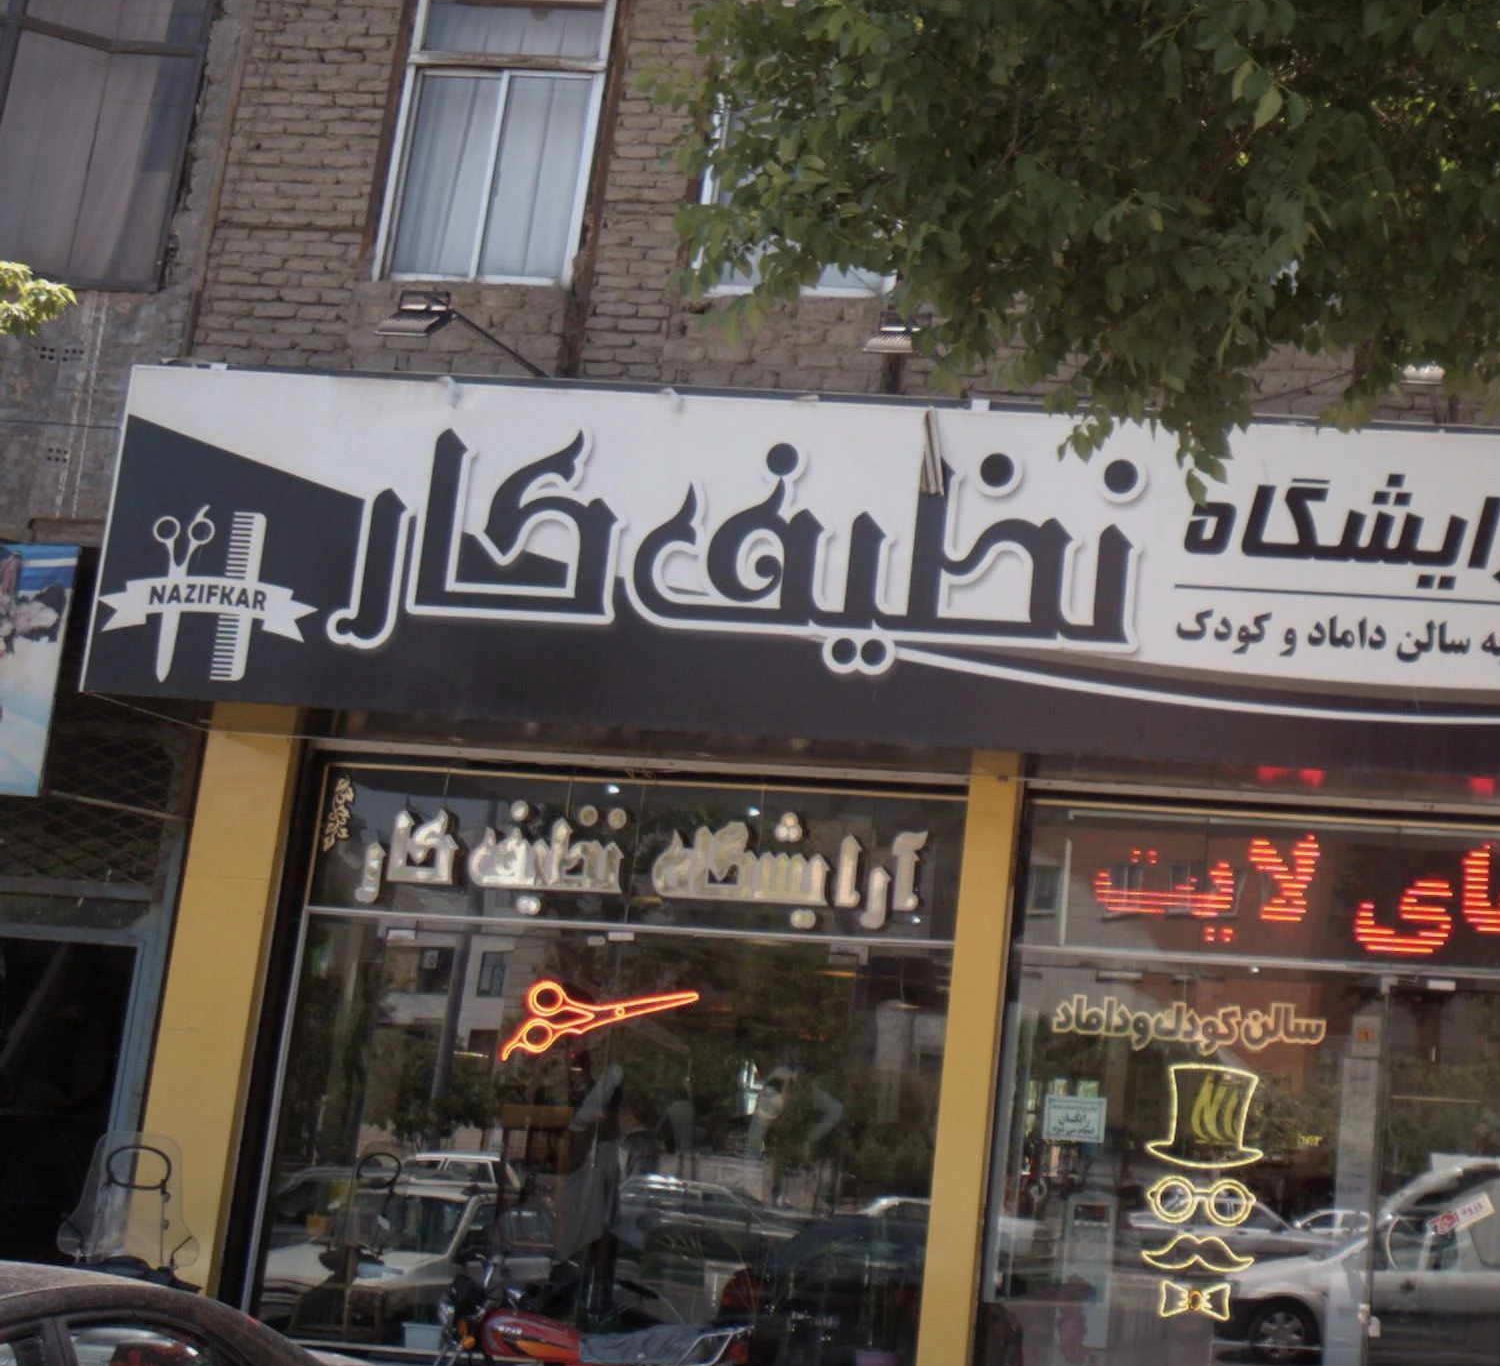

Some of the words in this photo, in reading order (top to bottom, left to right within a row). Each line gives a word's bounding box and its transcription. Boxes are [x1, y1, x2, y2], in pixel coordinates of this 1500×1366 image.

[332, 426, 620, 642] کار
[630, 440, 1136, 671] نظیف
[149, 584, 267, 611] NAZIFKAR
[1175, 608, 1273, 655] کودک
[1282, 621, 1298, 657] و
[1306, 615, 1388, 651] داماد
[1395, 620, 1472, 663] سالن
[354, 807, 461, 904] کار
[652, 811, 929, 930] آرایشگاه
[1052, 993, 1131, 1037] داماد
[1240, 1002, 1327, 1053] سالن
